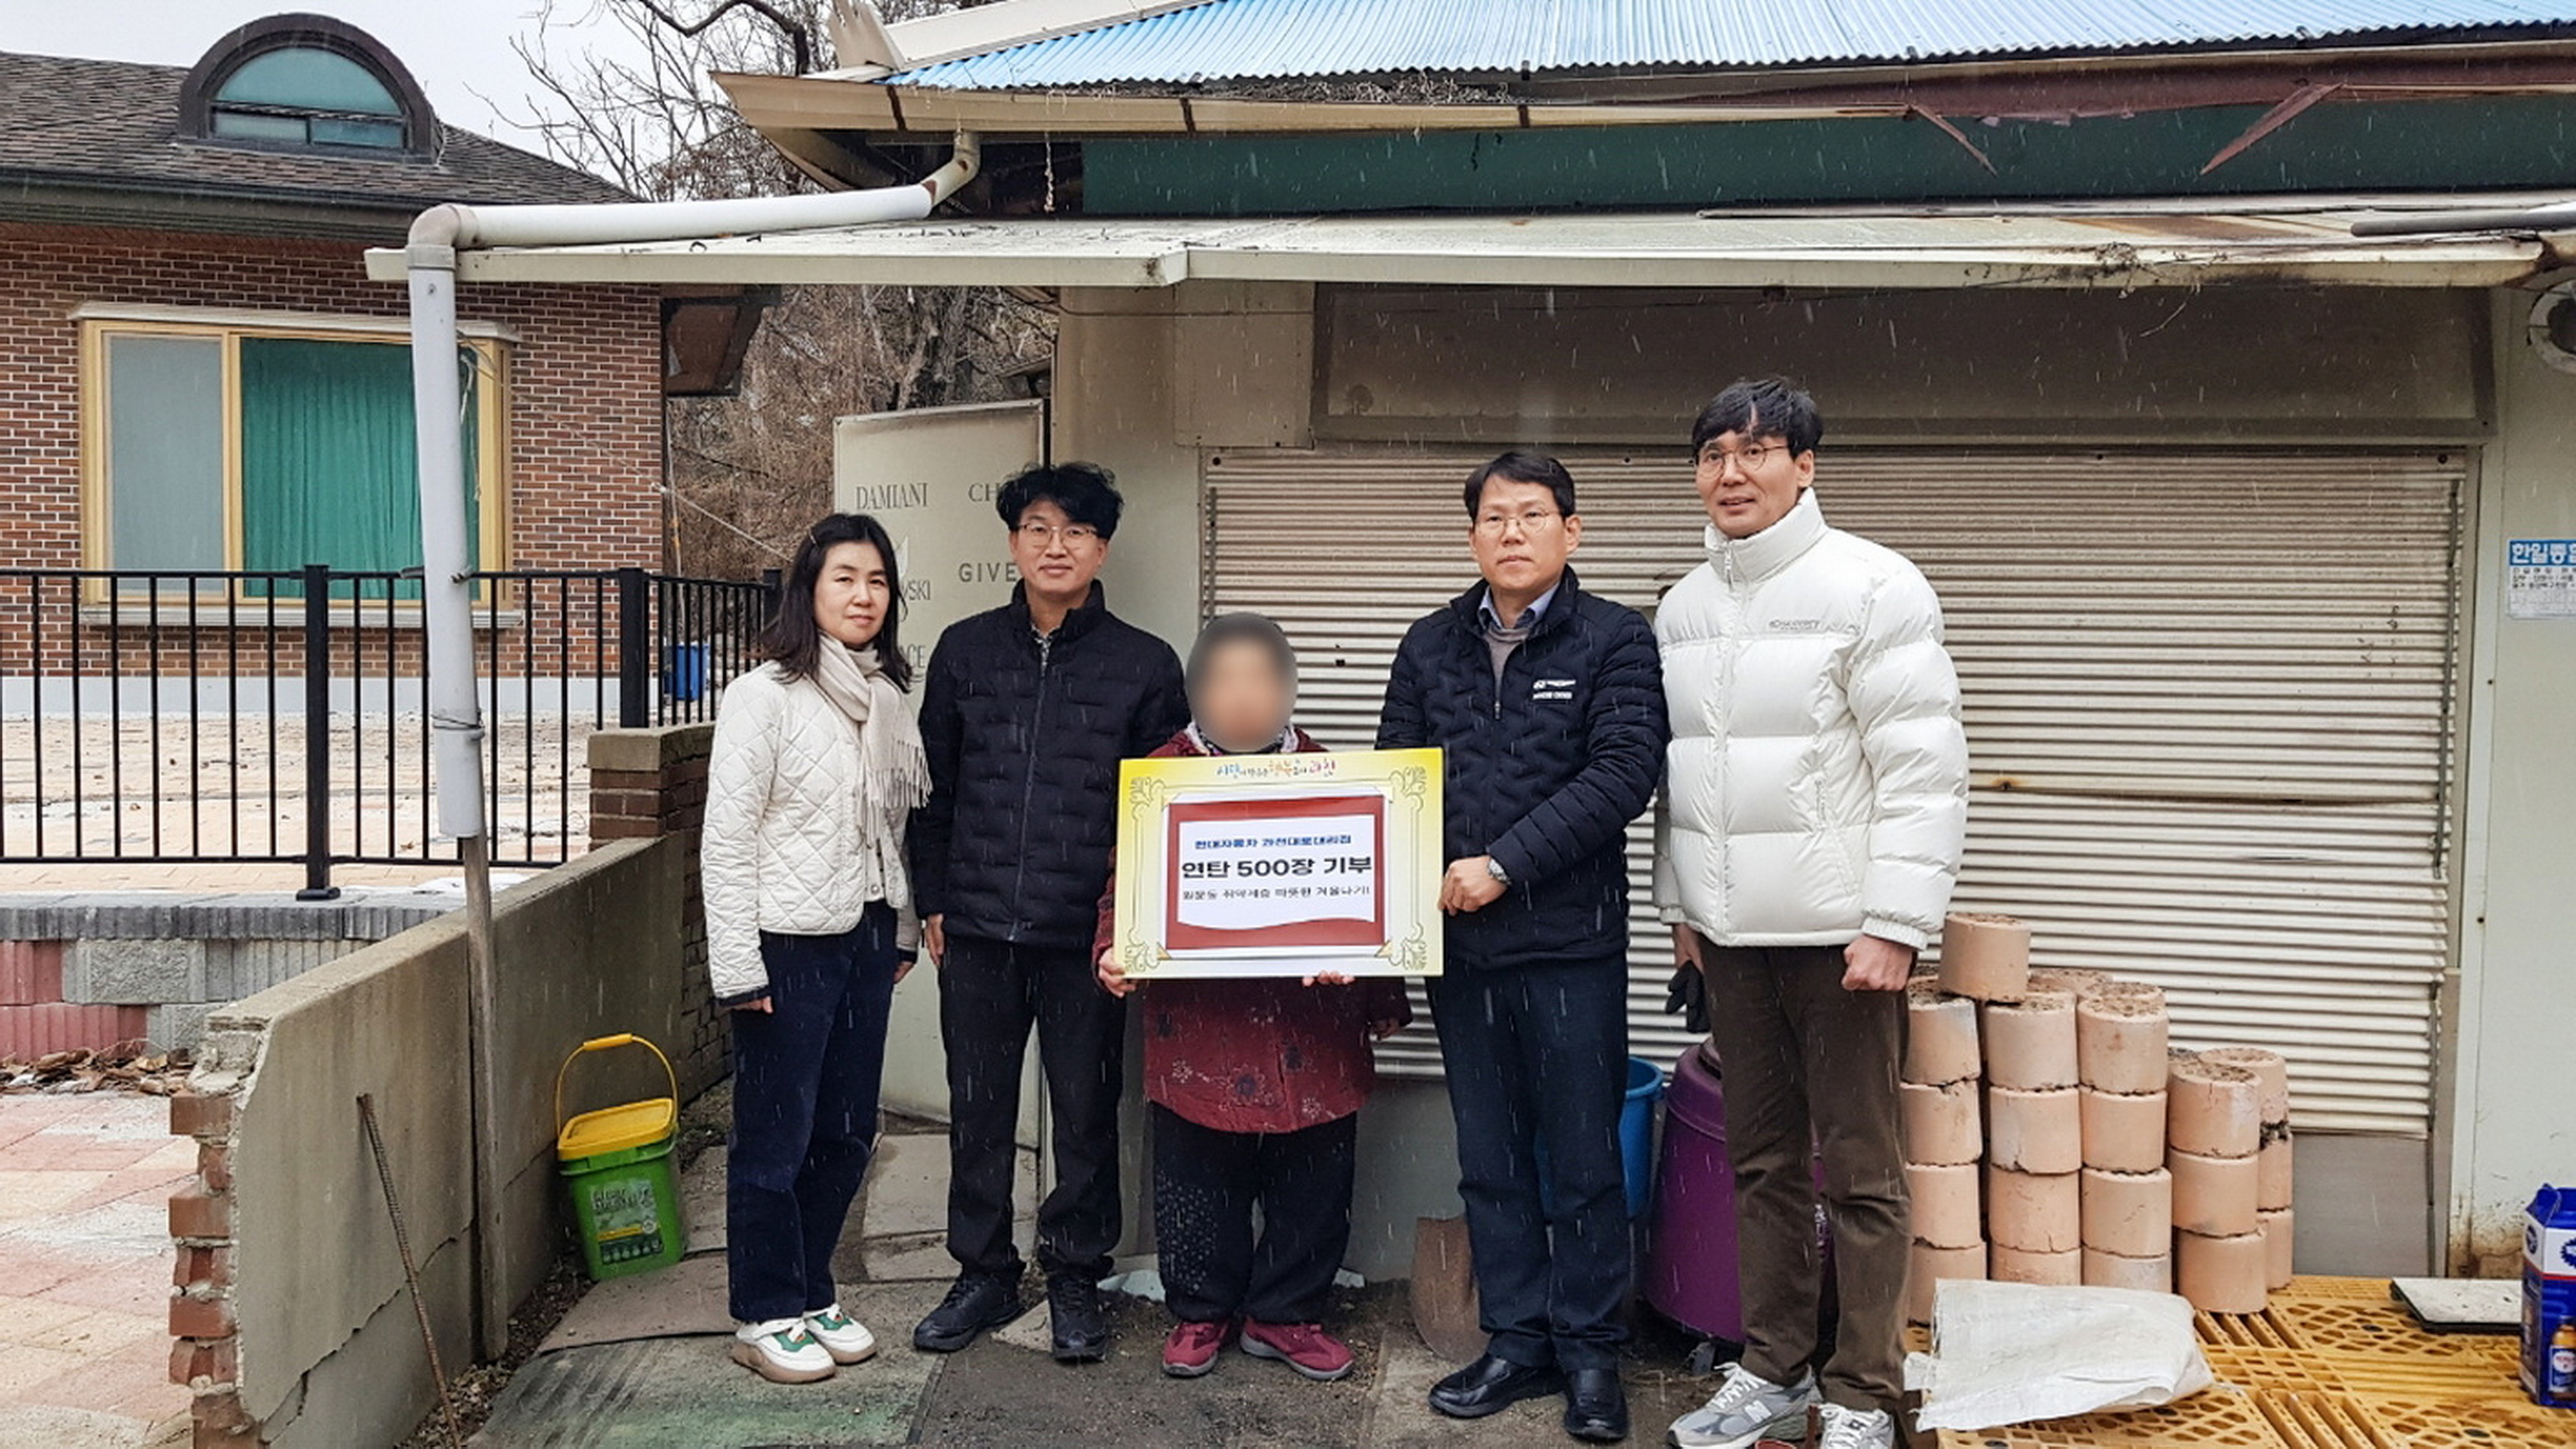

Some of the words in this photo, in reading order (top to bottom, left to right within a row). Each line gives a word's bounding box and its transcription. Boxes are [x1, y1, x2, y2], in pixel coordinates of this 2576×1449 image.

[856, 482, 928, 510] DAMIANI
[967, 482, 1001, 502] CH
[958, 563, 1018, 582] GIVE
[1195, 838, 1258, 849] 현대자동차
[1182, 861, 1230, 879] 연탄
[1237, 858, 1315, 877] 500장
[1323, 856, 1371, 874] 기부
[1275, 886, 1311, 899] 따뜻한
